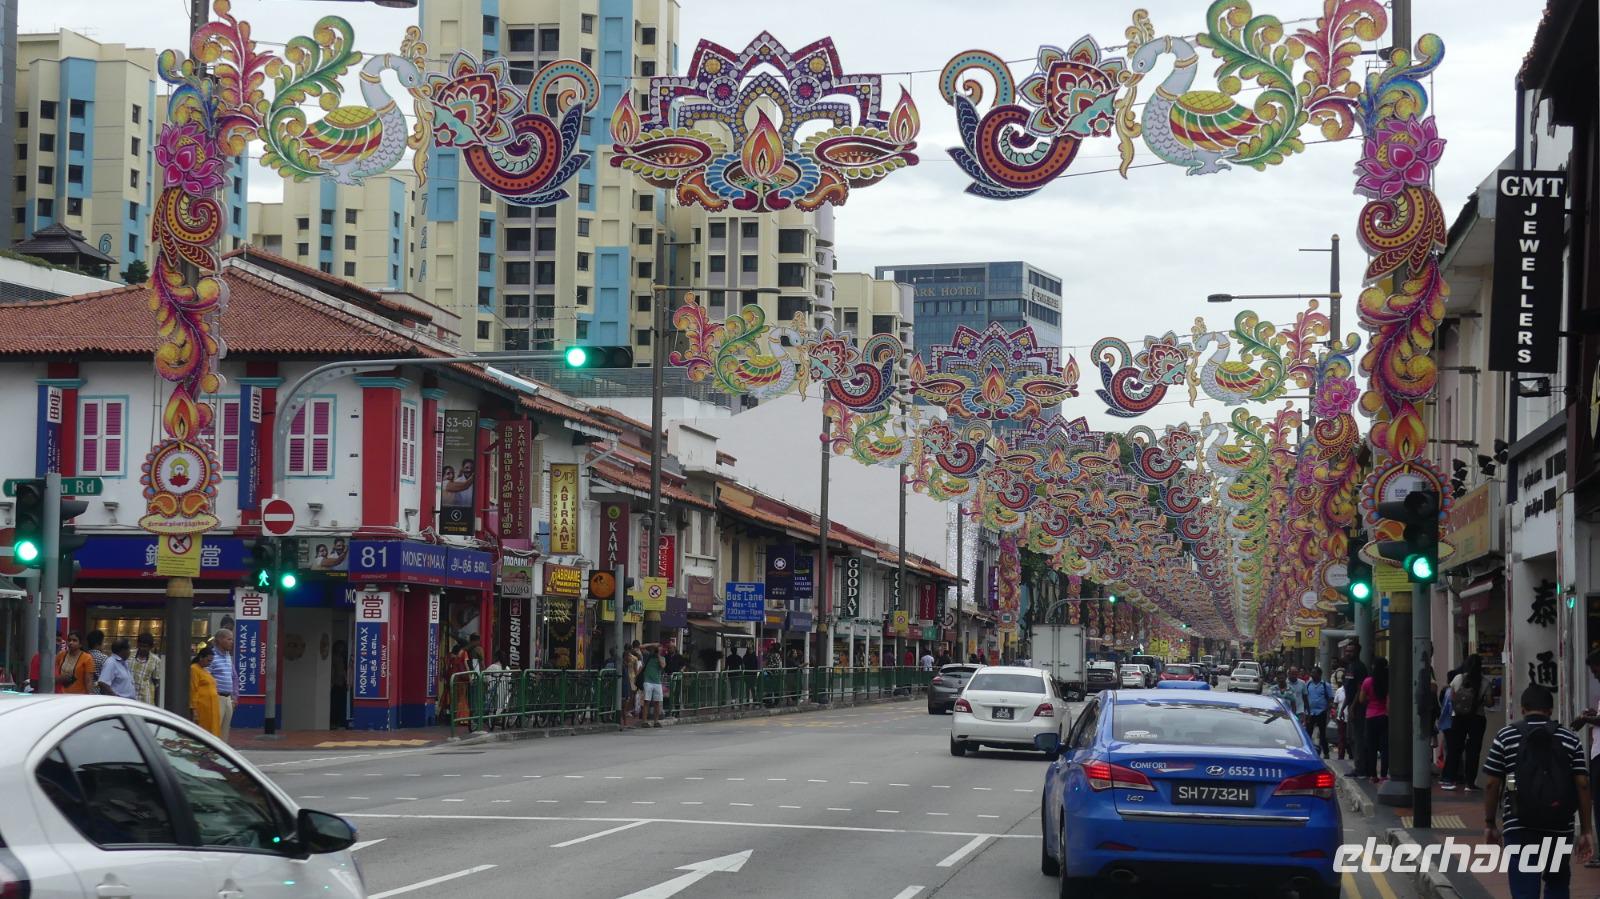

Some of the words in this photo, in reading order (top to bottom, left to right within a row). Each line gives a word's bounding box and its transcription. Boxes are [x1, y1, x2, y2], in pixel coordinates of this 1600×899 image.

[1500, 176, 1564, 198] GMT
[913, 287, 936, 297] ARK
[942, 287, 980, 297] HOTEL
[1517, 202, 1540, 364] JEWELLERS
[517, 425, 526, 468] KAMALA
[76, 481, 95, 494] Rd
[559, 486, 569, 550] ABIRAAME
[361, 546, 388, 568] 81
[727, 591, 742, 601] Bus
[744, 591, 763, 601] Lane
[847, 558, 859, 616] GOODAY
[510, 617, 521, 668] TOPCASH
[1130, 760, 1167, 769] COMFORT
[1228, 766, 1255, 777] 6552
[1259, 767, 1283, 778] 1111
[1178, 786, 1249, 801] SH7732H
